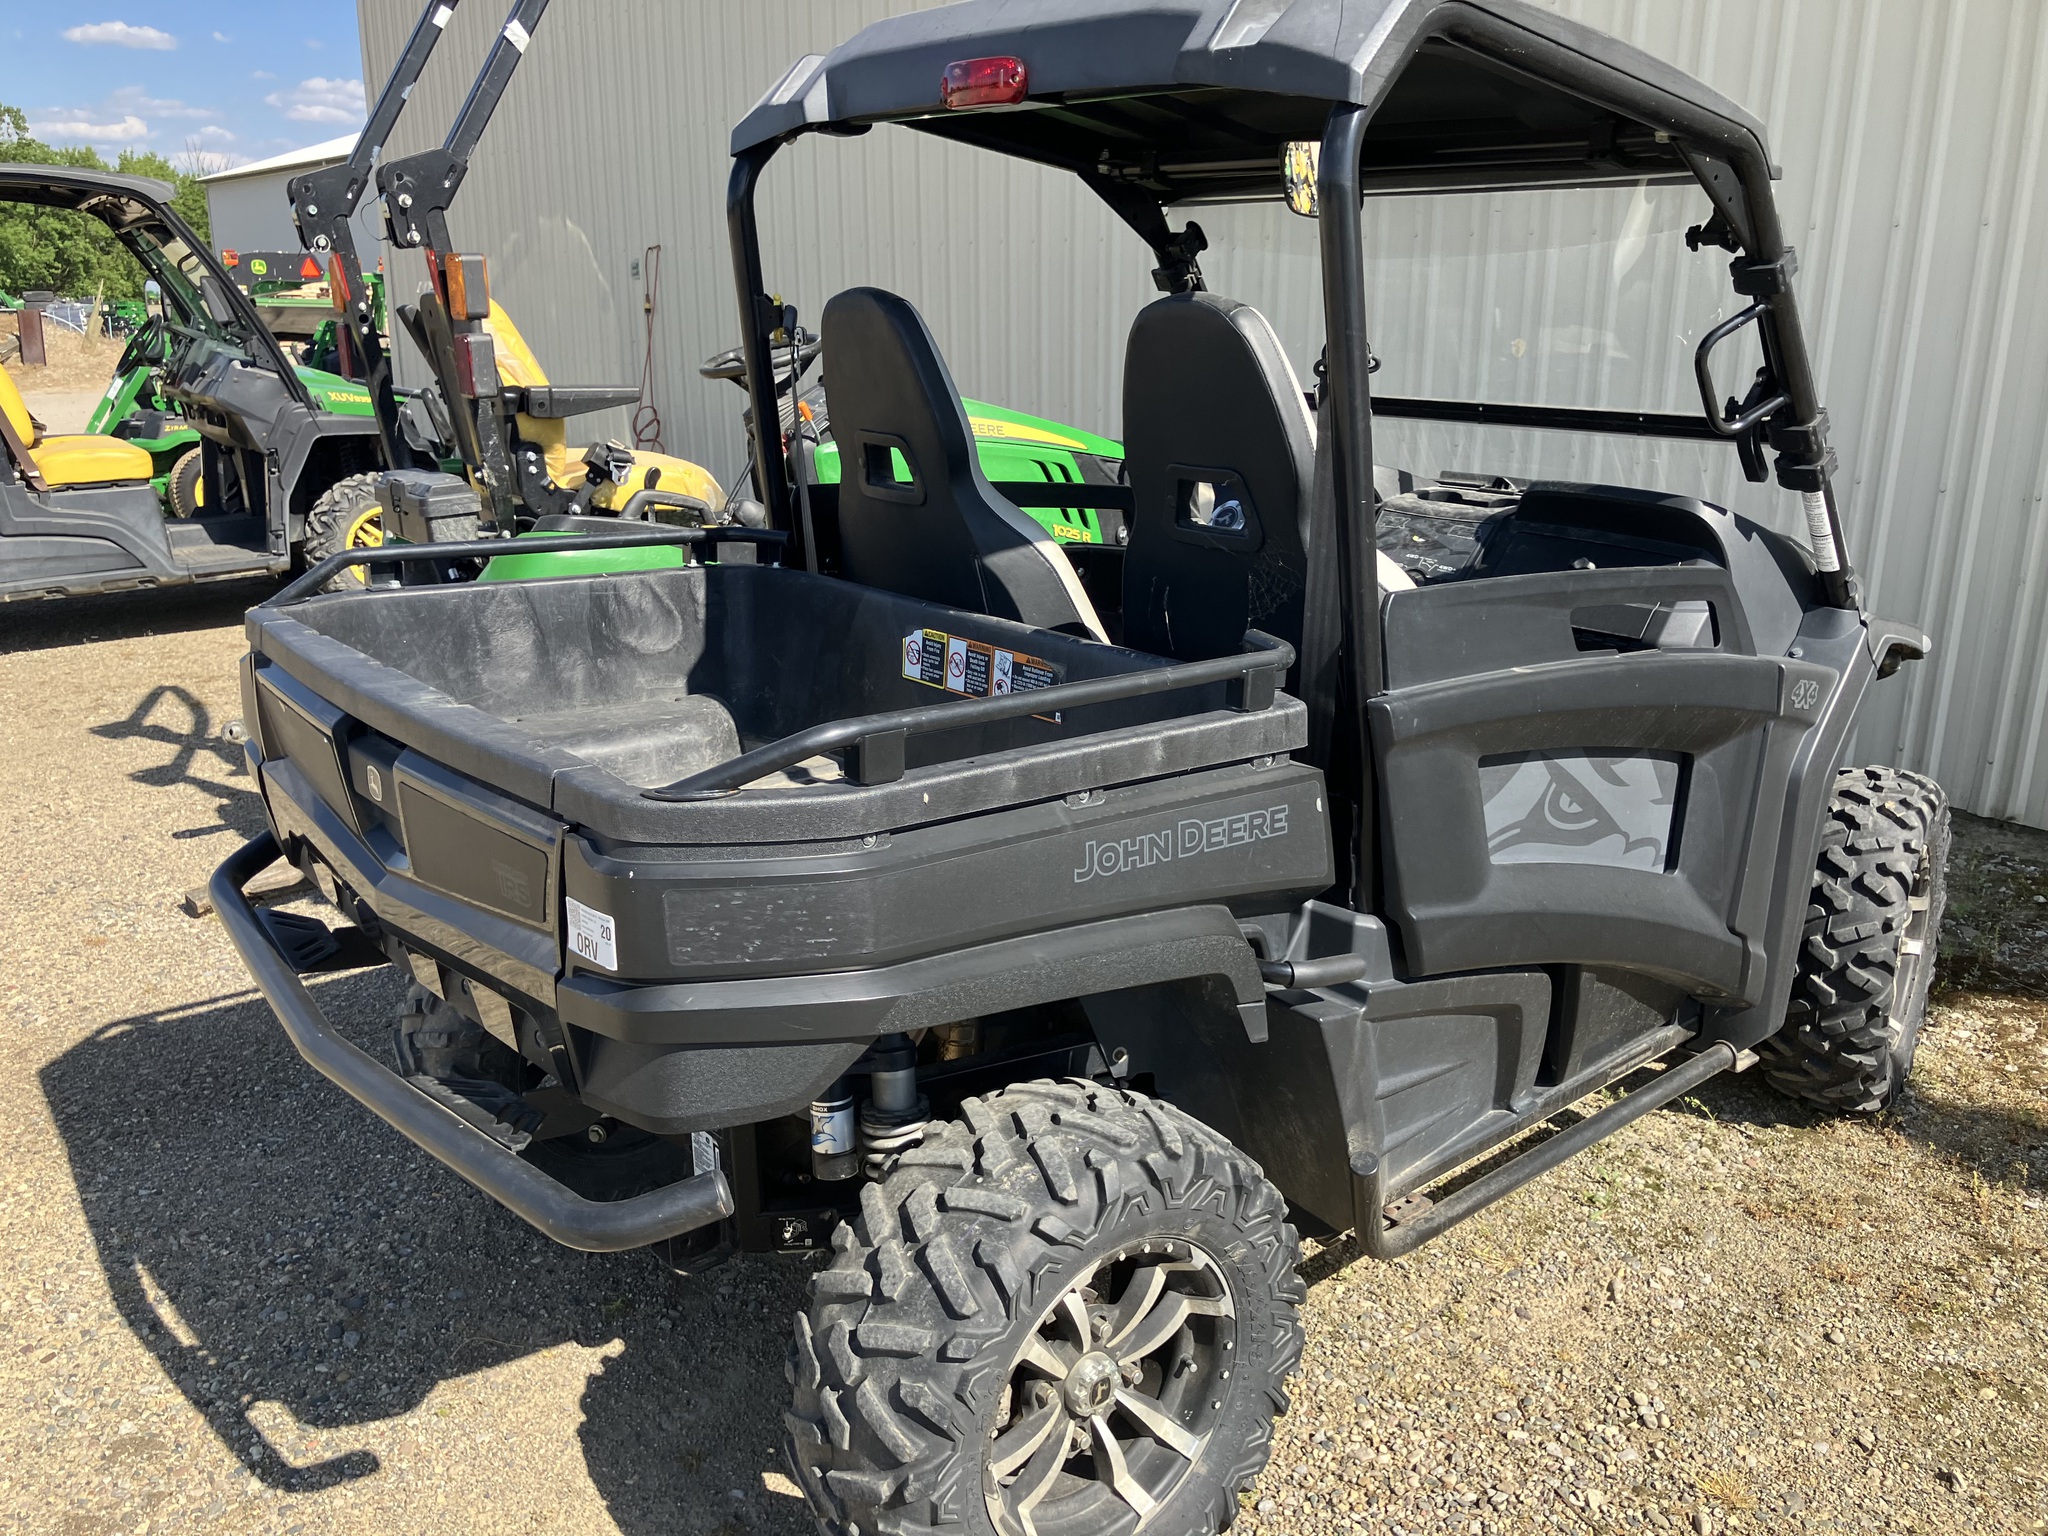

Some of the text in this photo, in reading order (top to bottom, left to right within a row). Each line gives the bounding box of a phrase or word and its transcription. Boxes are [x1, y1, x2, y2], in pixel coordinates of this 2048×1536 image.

[1053, 524, 1092, 543] 1025 R
[928, 632, 945, 641] CAUTION
[972, 642, 991, 653] WARNING
[1074, 804, 1289, 883] JOHN DEERE
[600, 924, 612, 941] 20
[577, 932, 598, 961] ORV
